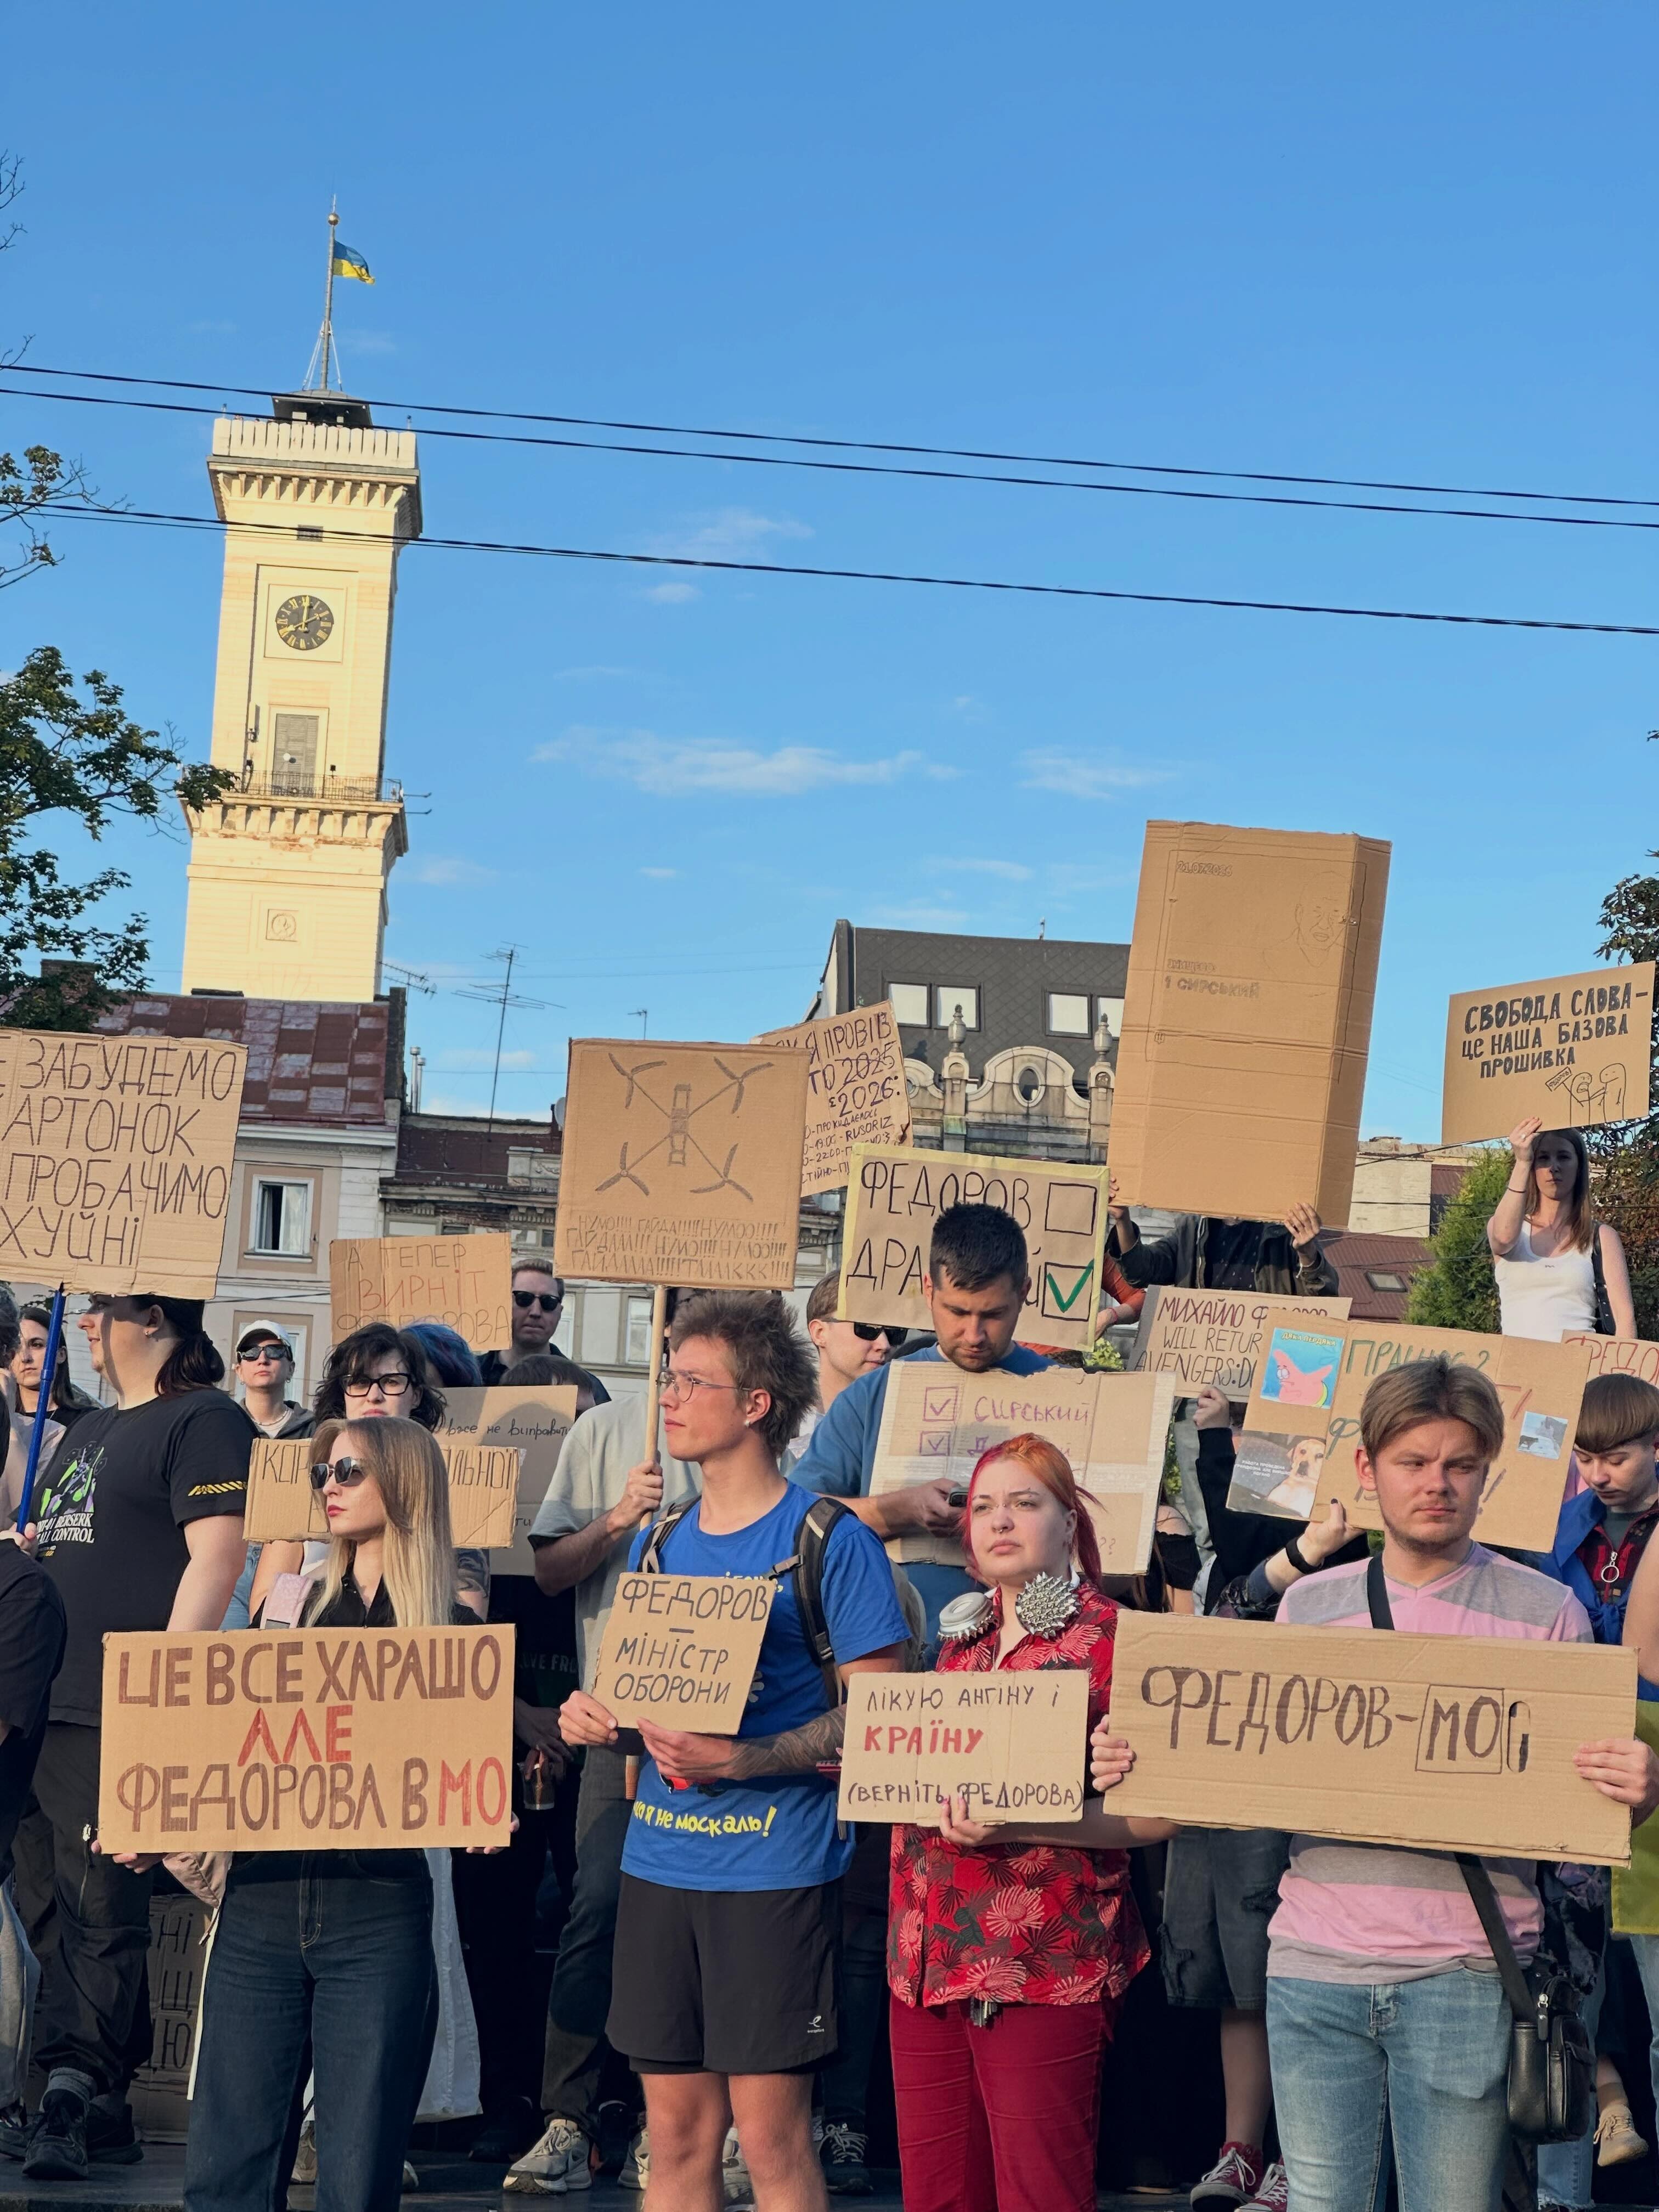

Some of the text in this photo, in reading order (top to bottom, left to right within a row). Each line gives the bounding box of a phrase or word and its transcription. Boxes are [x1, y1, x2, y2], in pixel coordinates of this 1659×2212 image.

[1464, 993, 1561, 1034] СВОБОДА
[823, 1012, 891, 1059] ПРОВІВ
[1491, 1027, 1542, 1056] НАША
[1558, 1013, 1628, 1045] БАЗОВА
[20, 1038, 236, 1101] ЗАБУДЕМО
[809, 1063, 835, 1095] ТО
[1480, 1046, 1575, 1079] ПРОШИВКА
[0, 1093, 201, 1156] АРТОНОК
[5, 1153, 227, 1218] ПРОБАЧИМО
[861, 1161, 1031, 1229] ФЕДОРОВ
[0, 1205, 139, 1265] ХУЙНІ
[348, 1244, 466, 1272] А ТЕПЕР
[359, 1269, 485, 1311] ВИРНІТ
[1157, 1297, 1245, 1328] МИХАЙЛО
[1163, 1326, 1262, 1354] WILL RETUR
[974, 1396, 1090, 1425] СИРСЬКИЙ
[487, 1425, 500, 1434] не
[51, 1527, 95, 1543] CONTROL
[54, 1513, 93, 1528] BERSERK
[622, 1578, 768, 1621] ФЕДОРОВ
[119, 1634, 501, 1708] ЦЕ ВСЕ ХАРАШО
[614, 1632, 729, 1675] МІНІСТР
[614, 1673, 731, 1705] ОБОРОНИ
[867, 1688, 943, 1712] ЛІКУЮ
[958, 1685, 1034, 1707] АНГІНУ
[864, 1719, 984, 1755] КРАЇНУ
[116, 1756, 507, 1832] ФЕДОРОВА В МО
[957, 1781, 1084, 1813] ФЕДОРОВА)
[675, 1805, 777, 1838] москаль!
